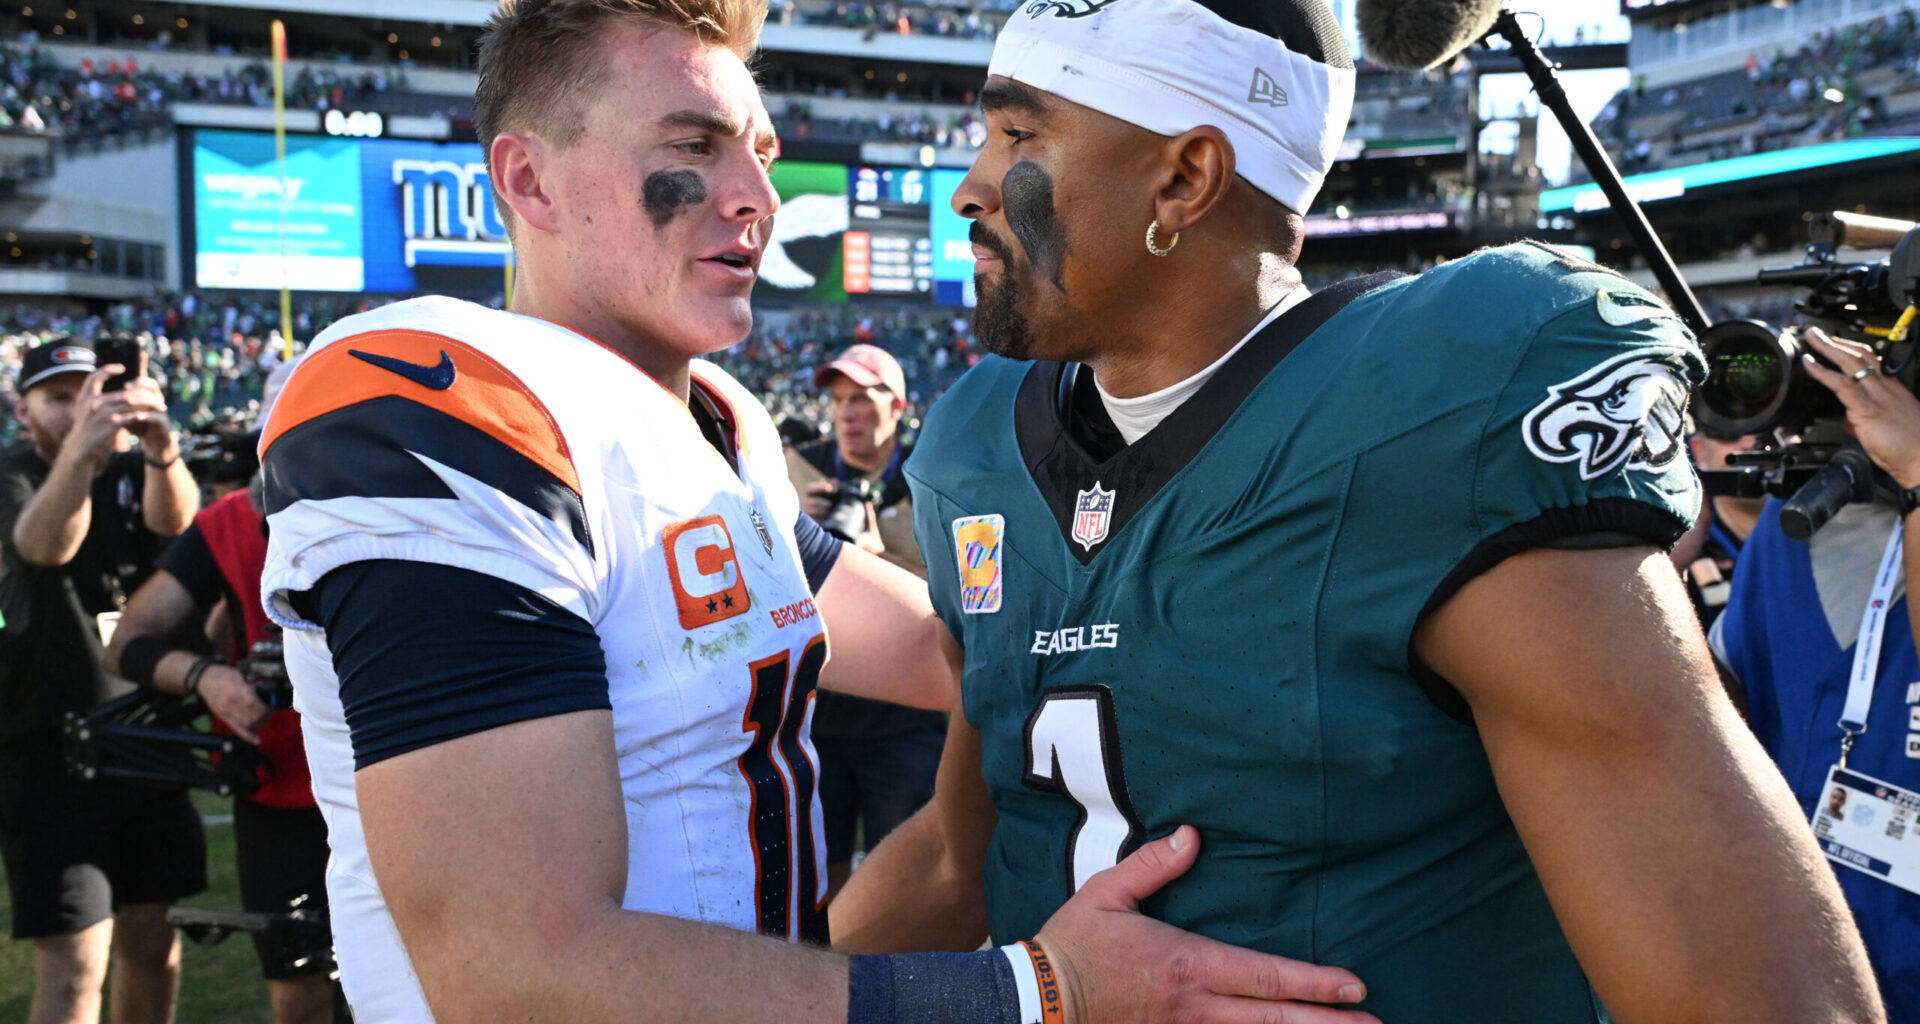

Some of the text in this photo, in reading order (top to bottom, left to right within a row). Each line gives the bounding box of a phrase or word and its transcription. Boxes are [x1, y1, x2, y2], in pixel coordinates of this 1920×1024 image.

[674, 523, 738, 598] C
[957, 521, 997, 588] C
[1077, 512, 1104, 540] NFL
[1030, 620, 1120, 656] EAGLES
[738, 634, 829, 944] 10
[1022, 684, 1146, 908] 1
